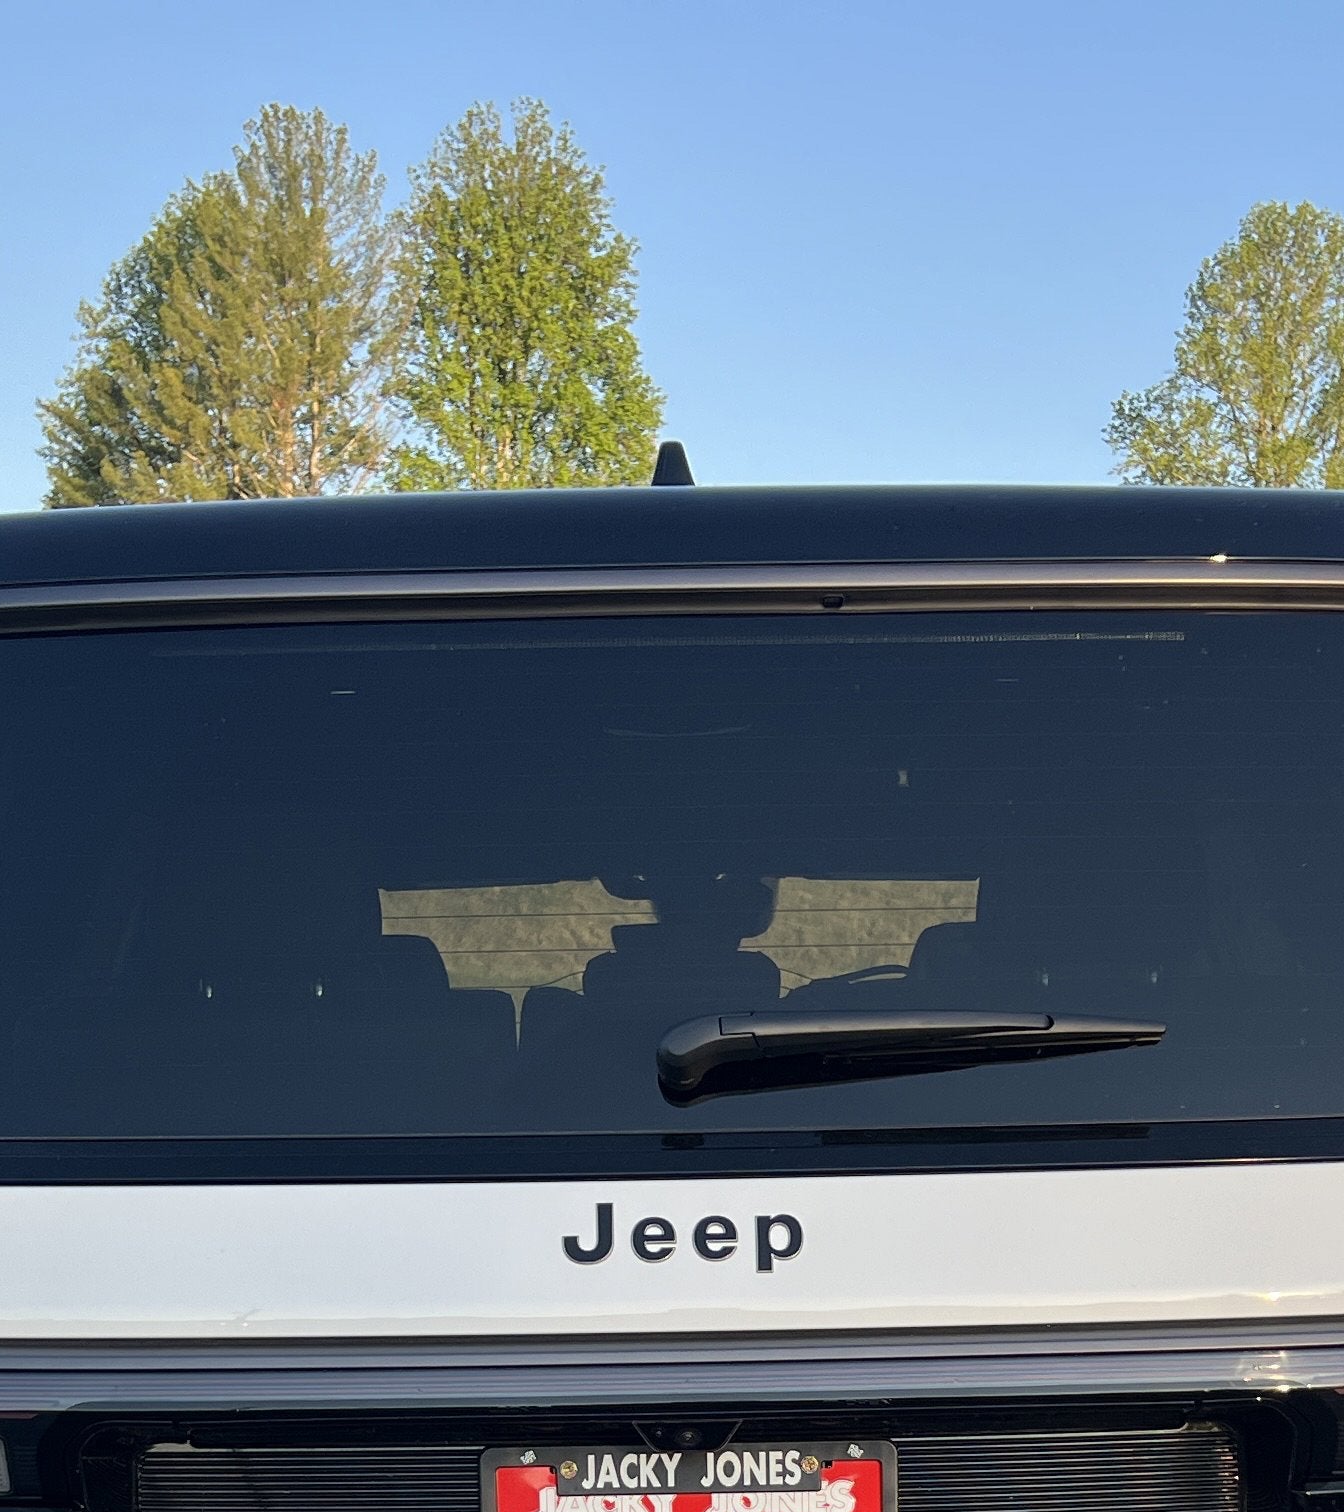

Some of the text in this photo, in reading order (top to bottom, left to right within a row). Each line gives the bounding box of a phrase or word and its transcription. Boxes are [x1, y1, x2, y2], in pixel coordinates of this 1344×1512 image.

[561, 1202, 804, 1273] Jeep
[581, 1450, 802, 1489] JACKY JONES
